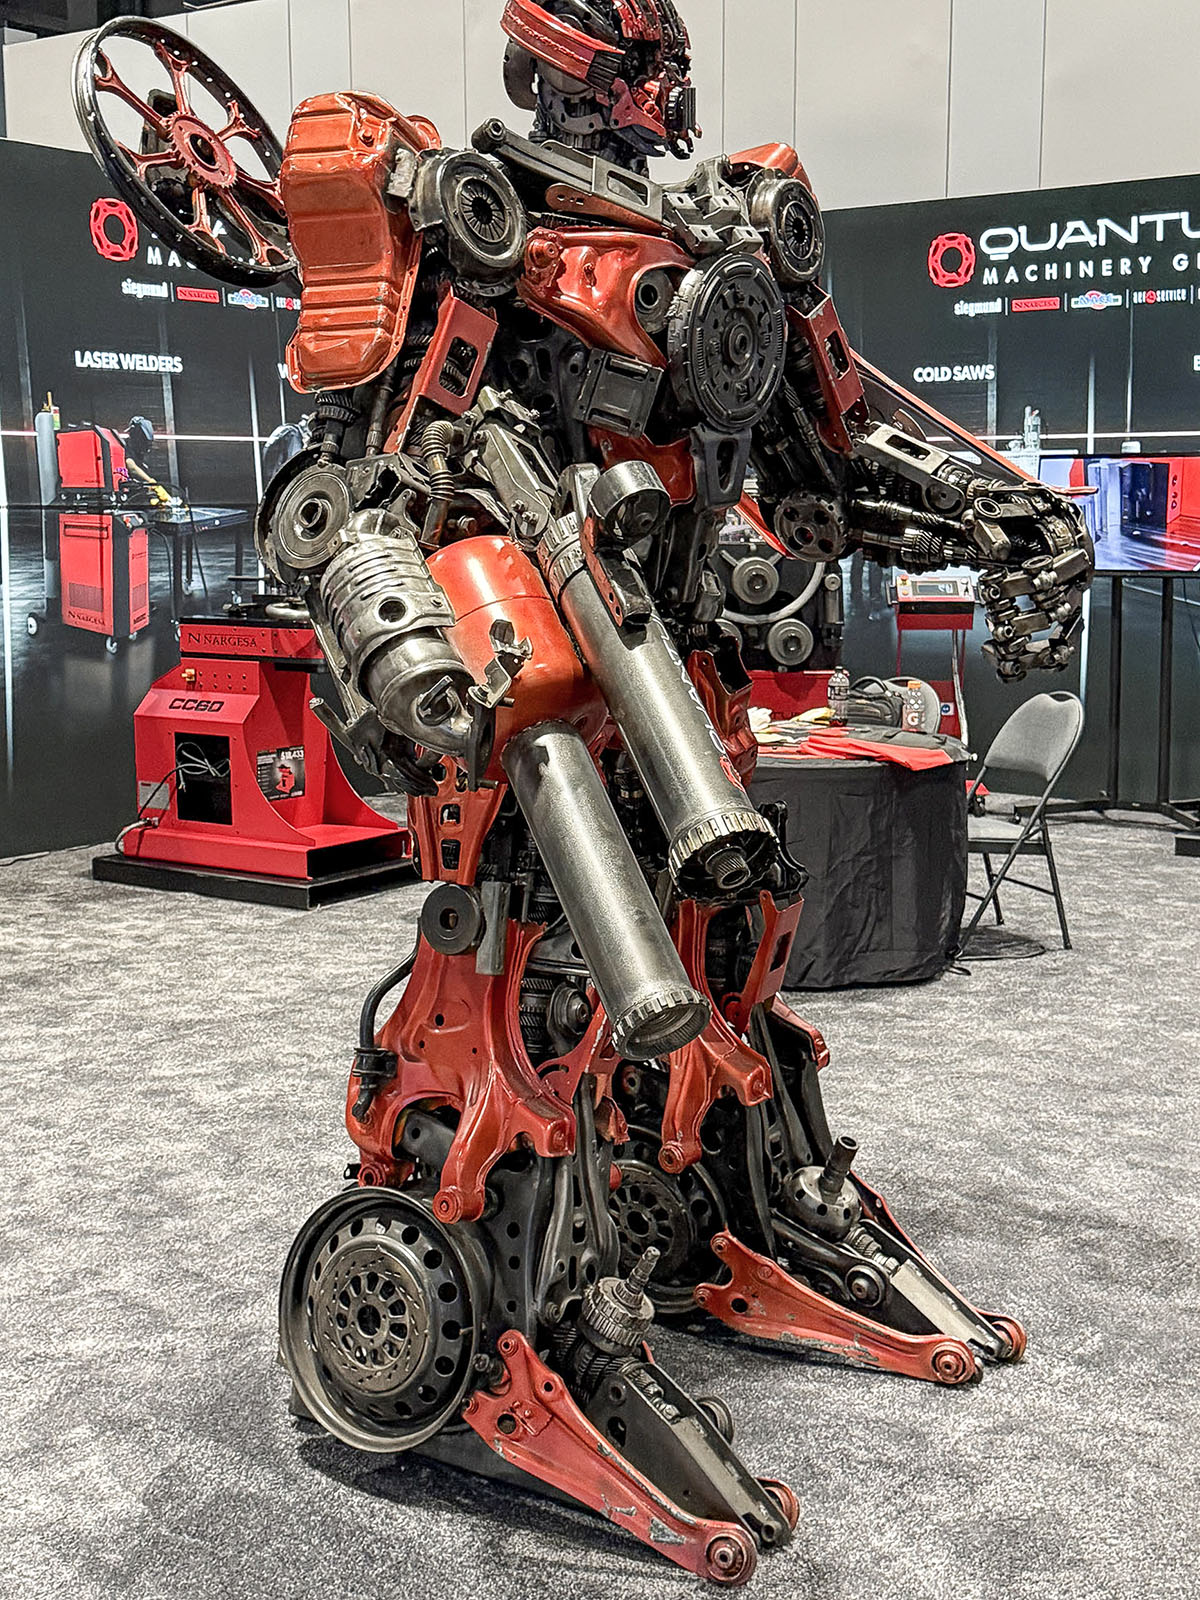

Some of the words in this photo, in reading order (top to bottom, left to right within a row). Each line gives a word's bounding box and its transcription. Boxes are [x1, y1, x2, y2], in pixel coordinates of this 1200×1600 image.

[982, 255, 1153, 286] MACHINERY
[74, 351, 119, 370] LASER
[119, 353, 183, 373] WELDERS
[913, 366, 952, 383] COLD
[952, 364, 995, 381] SAWS
[203, 634, 257, 648] NARGESA
[169, 698, 225, 713] CC60
